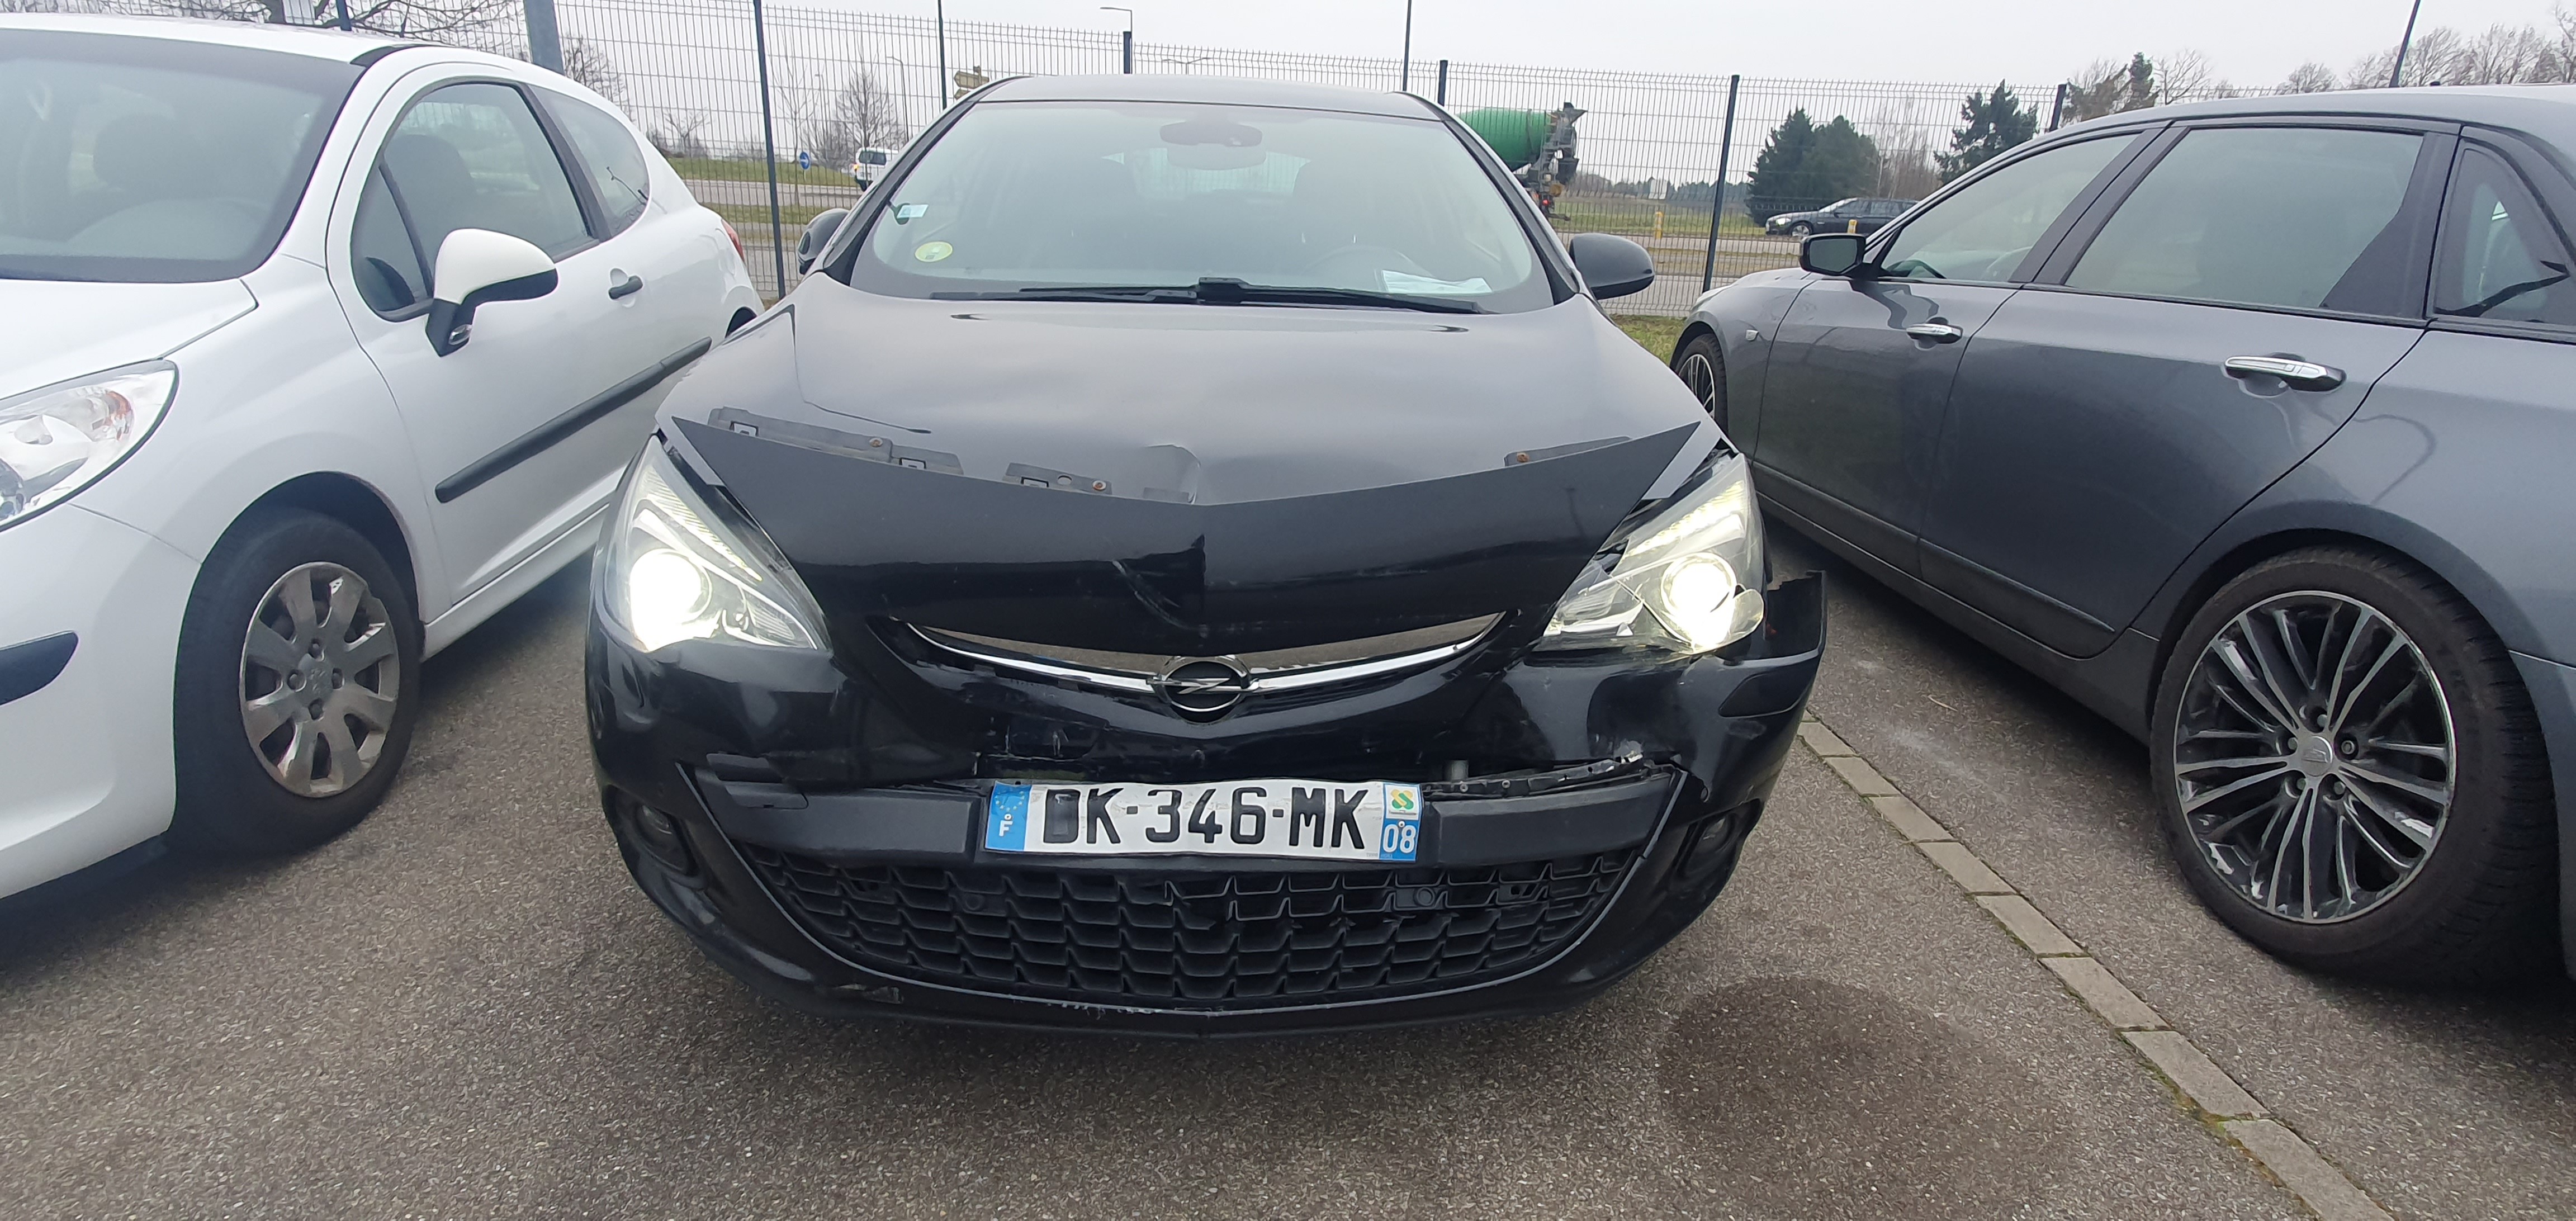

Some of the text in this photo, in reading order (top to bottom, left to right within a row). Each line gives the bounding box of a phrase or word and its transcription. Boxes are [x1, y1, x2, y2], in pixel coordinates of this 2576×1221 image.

[999, 820, 1014, 836] F
[1043, 787, 1368, 849] DK-346-MK
[1383, 824, 1417, 854] 08
